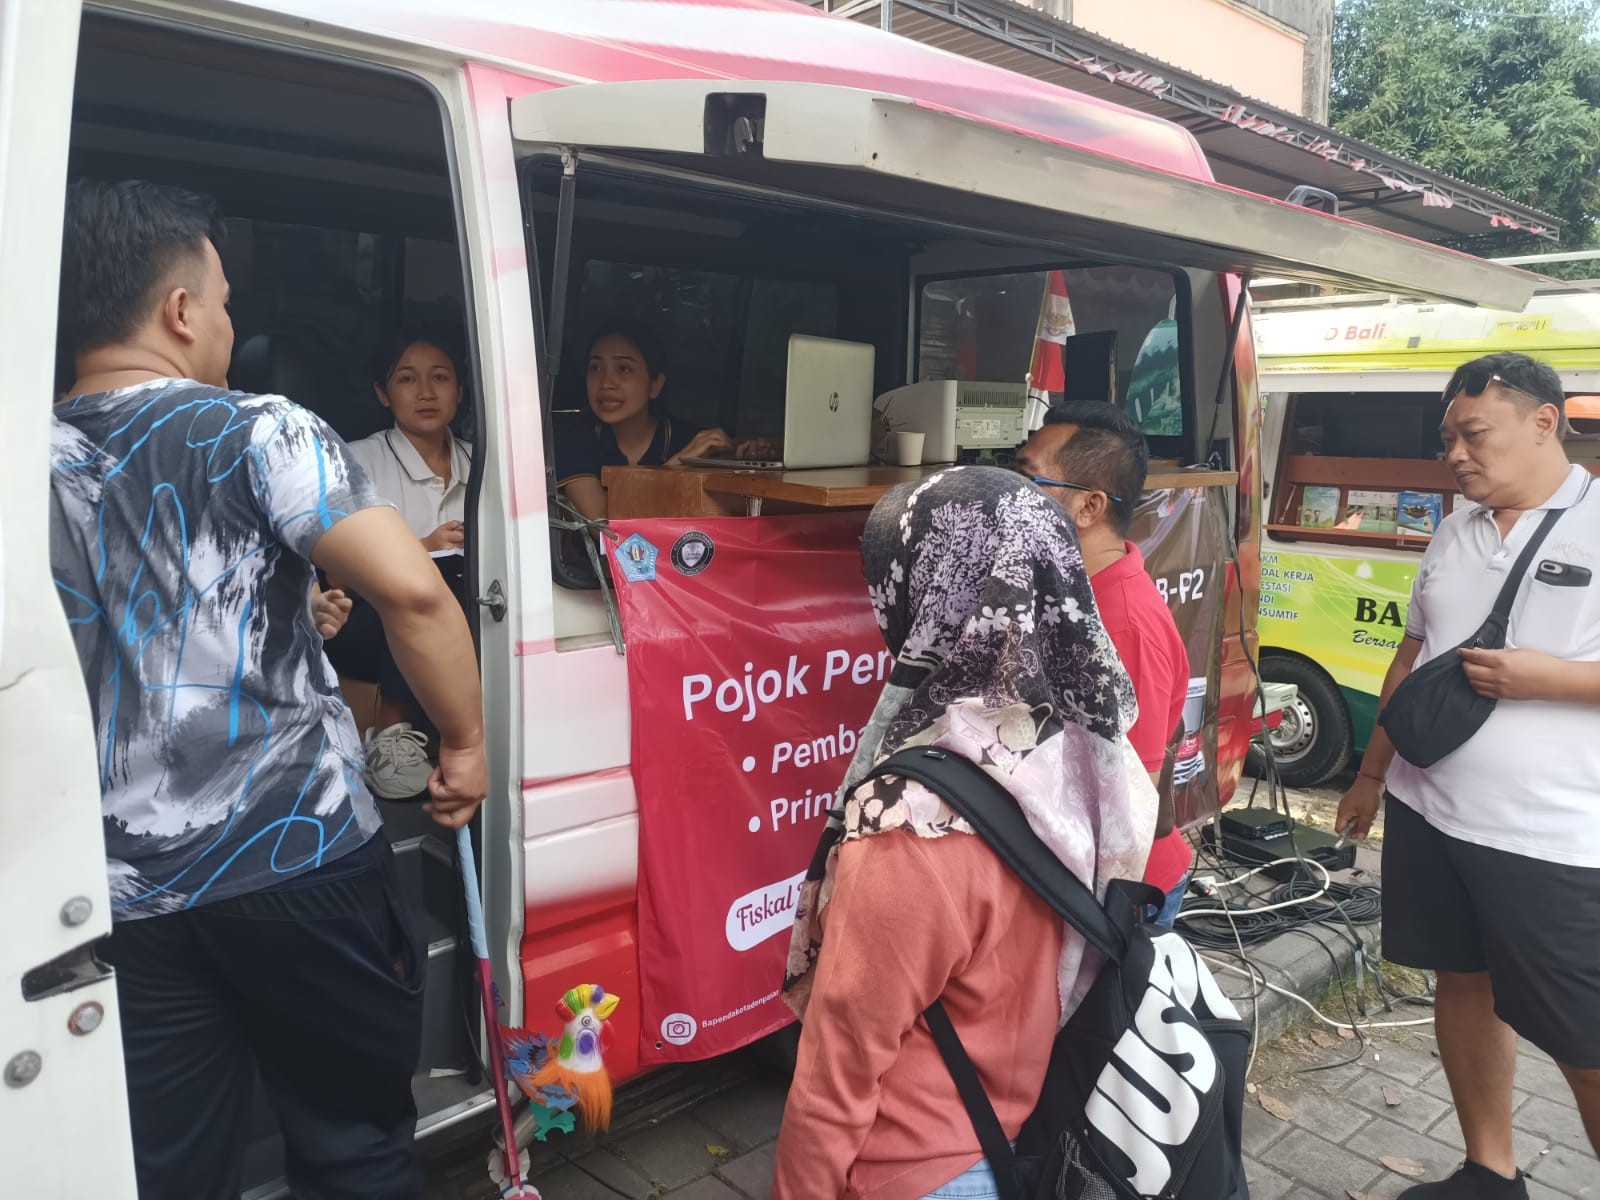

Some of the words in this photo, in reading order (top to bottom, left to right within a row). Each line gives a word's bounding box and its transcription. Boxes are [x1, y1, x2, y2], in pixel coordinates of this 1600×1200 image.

[1344, 321, 1387, 341] Bali
[1284, 570, 1314, 582] KERJA
[1354, 597, 1408, 628] BA
[682, 655, 811, 722] Pojok
[736, 884, 795, 932] Fiskal
